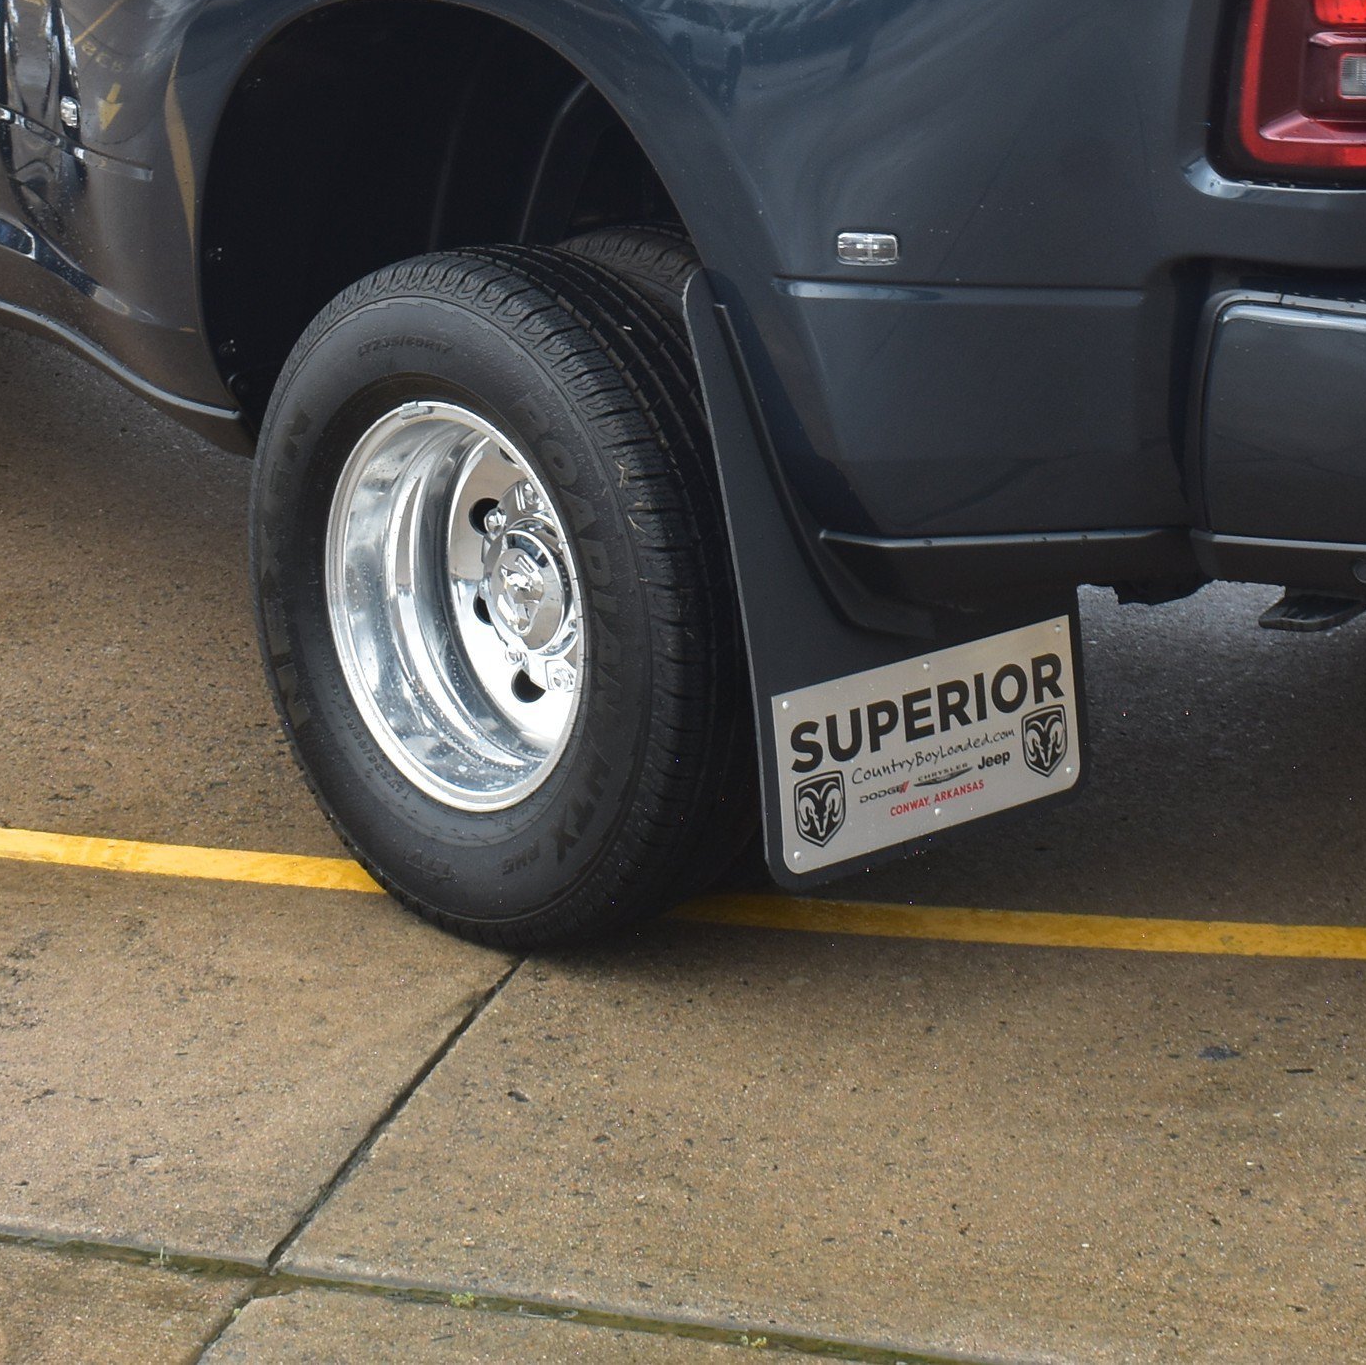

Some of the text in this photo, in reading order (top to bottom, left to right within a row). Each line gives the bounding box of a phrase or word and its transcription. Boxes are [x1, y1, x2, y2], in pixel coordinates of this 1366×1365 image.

[790, 653, 1065, 773] SUPERIOR
[851, 729, 1015, 785] CountryBoyLoaded.com
[859, 751, 1011, 804] DODGE CHRYSLER Jeep
[890, 779, 985, 817] CONWAY, ARKANSAS
